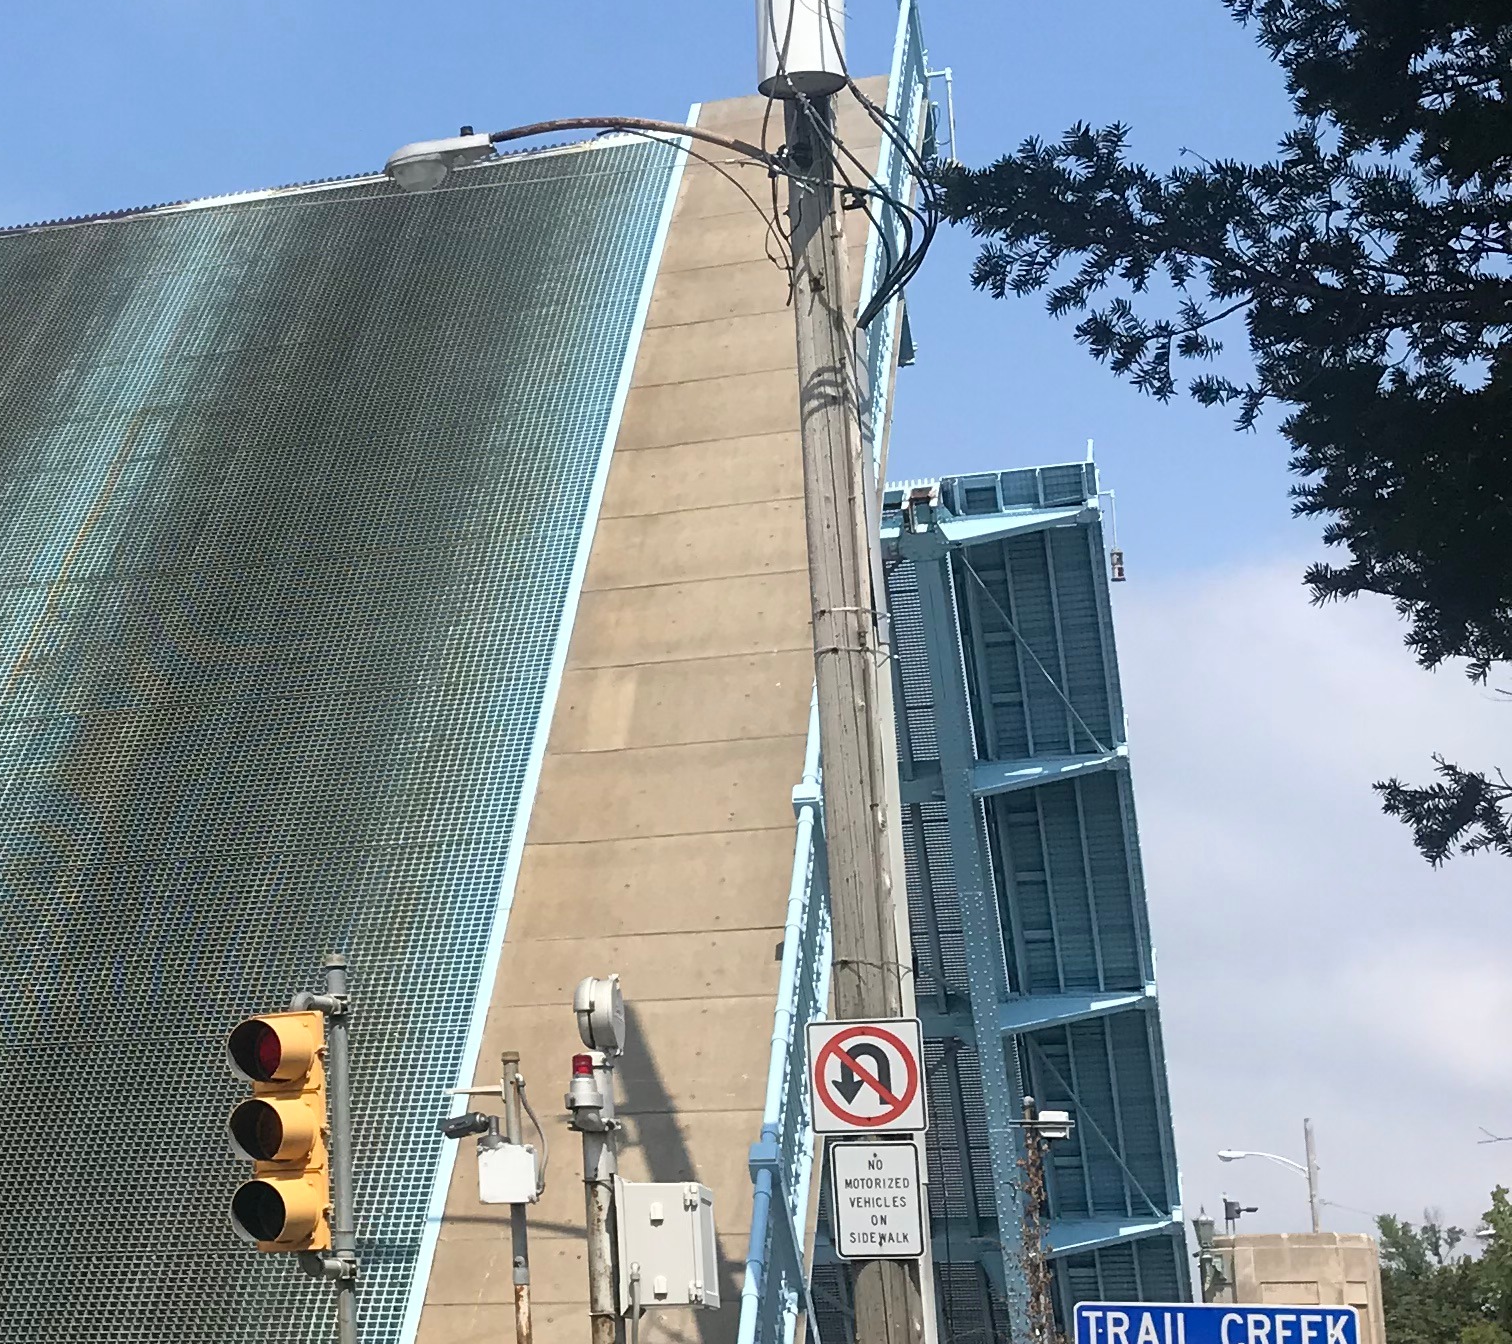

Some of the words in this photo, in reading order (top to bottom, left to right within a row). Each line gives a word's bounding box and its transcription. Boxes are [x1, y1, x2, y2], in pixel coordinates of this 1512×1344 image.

[868, 1159, 883, 1171] NO
[844, 1177, 910, 1189] MOTORIZED
[849, 1196, 907, 1208] VEHICLES
[870, 1214, 887, 1226] ON
[849, 1232, 909, 1244] SIDEWALK
